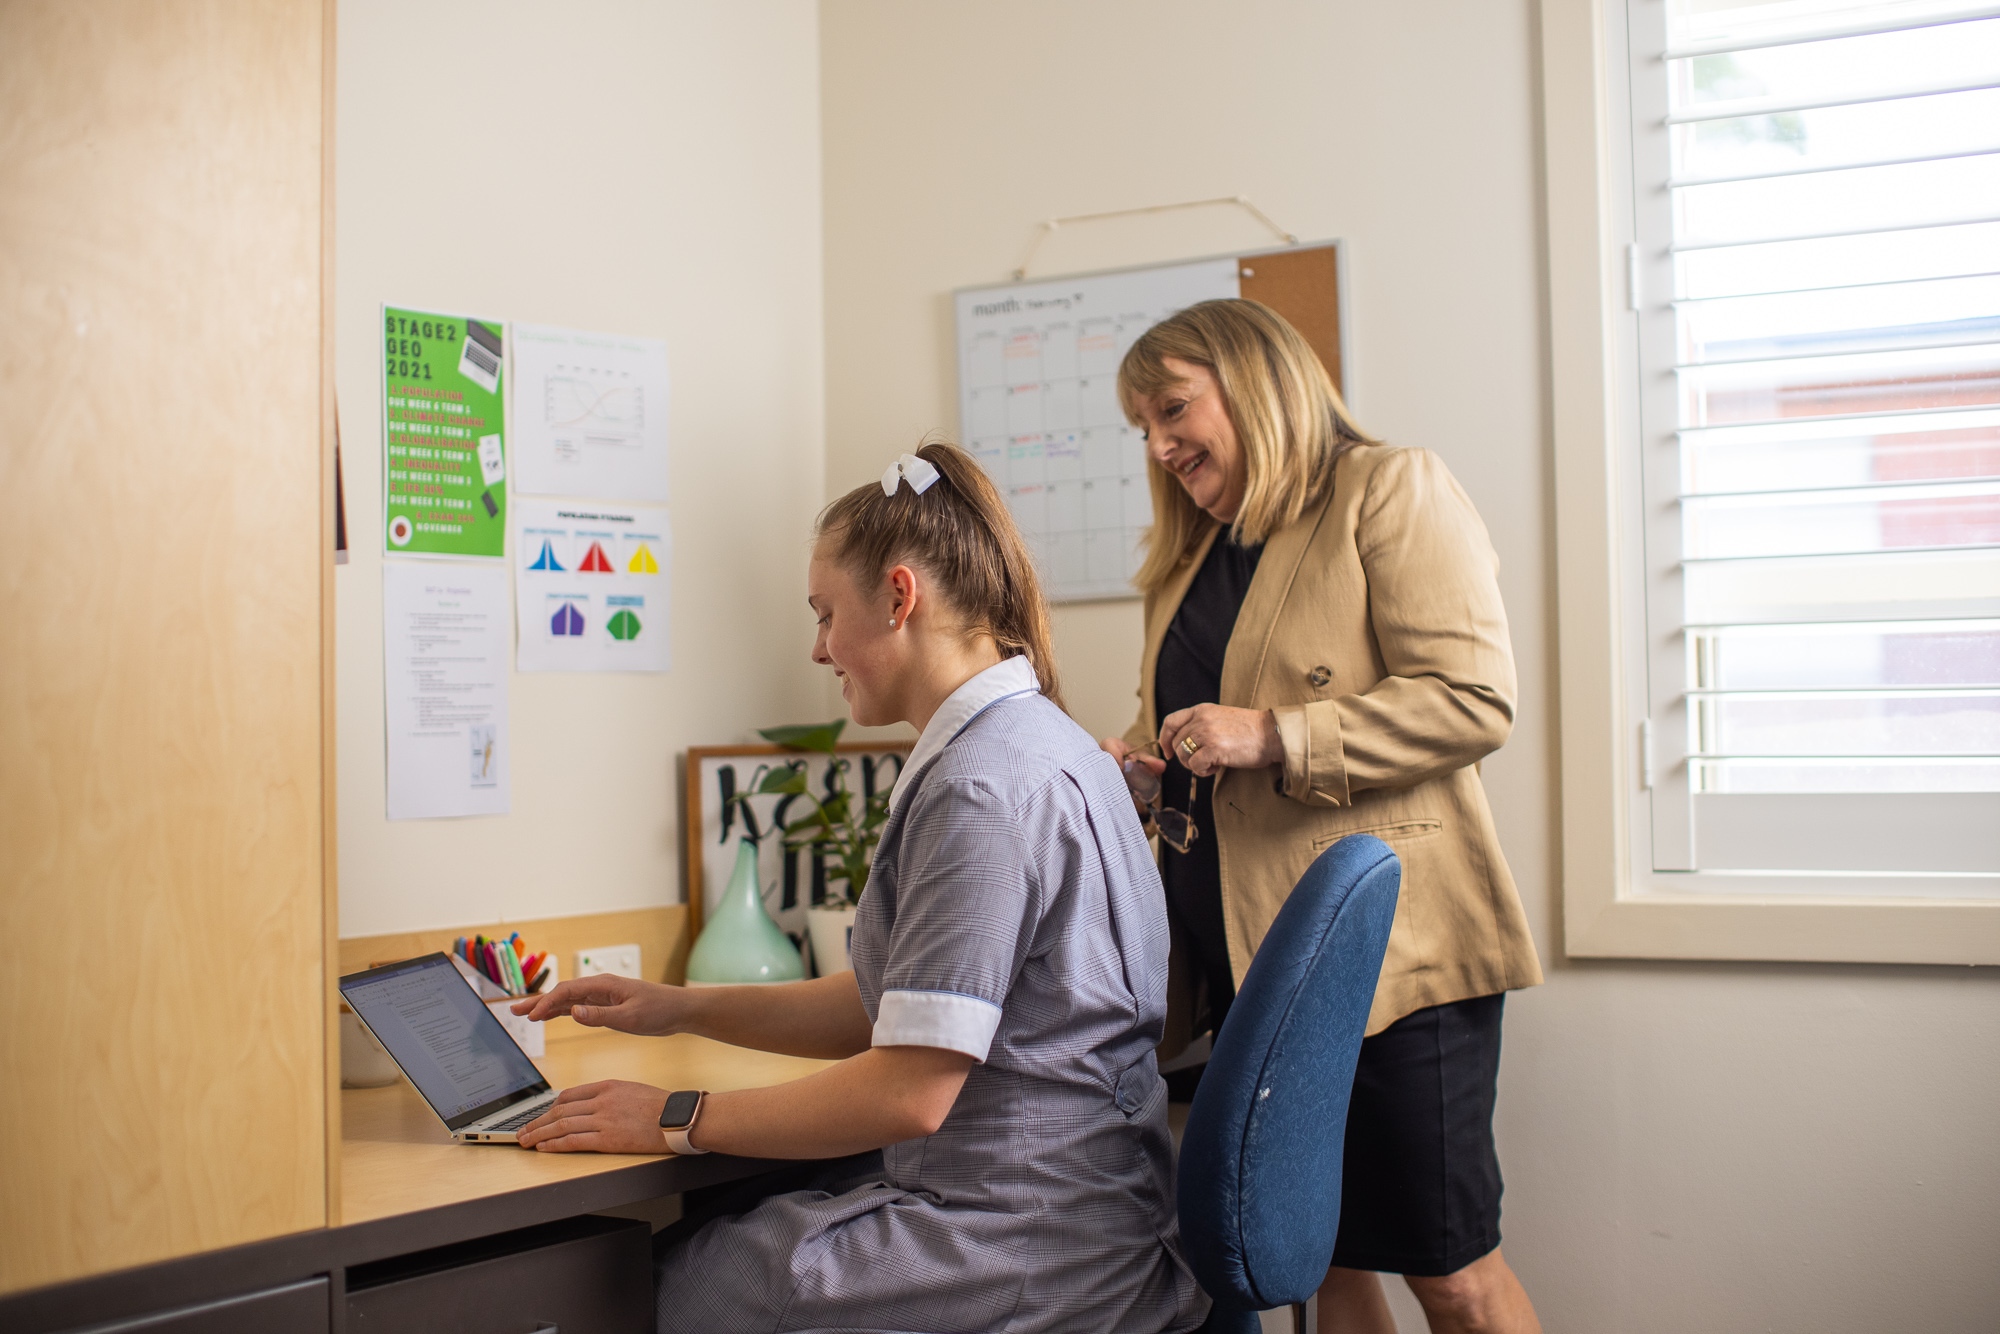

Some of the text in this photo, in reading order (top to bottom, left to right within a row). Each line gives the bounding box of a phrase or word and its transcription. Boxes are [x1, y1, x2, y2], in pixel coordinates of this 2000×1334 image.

[386, 336, 422, 358] GEO
[387, 357, 433, 381] 2021
[388, 396, 406, 408] DUE
[408, 398, 432, 411] WEEK
[442, 402, 464, 414] TERM
[402, 409, 445, 424] CLIMATE
[389, 420, 407, 432] DUE
[409, 422, 432, 434] WEEK
[442, 426, 464, 438] TERM
[390, 444, 407, 457] DUE
[409, 446, 432, 459] WEEK
[442, 450, 464, 463] TERM
[403, 459, 460, 473] INEQUALITY
[390, 469, 407, 481] DUE
[409, 470, 433, 483] WEEK
[443, 474, 464, 486] TERM
[390, 494, 407, 505] DUE
[409, 495, 433, 507] WEEK
[443, 498, 465, 510] TERM
[429, 511, 455, 522] EXAM
[415, 522, 463, 535] NOVEMBER
